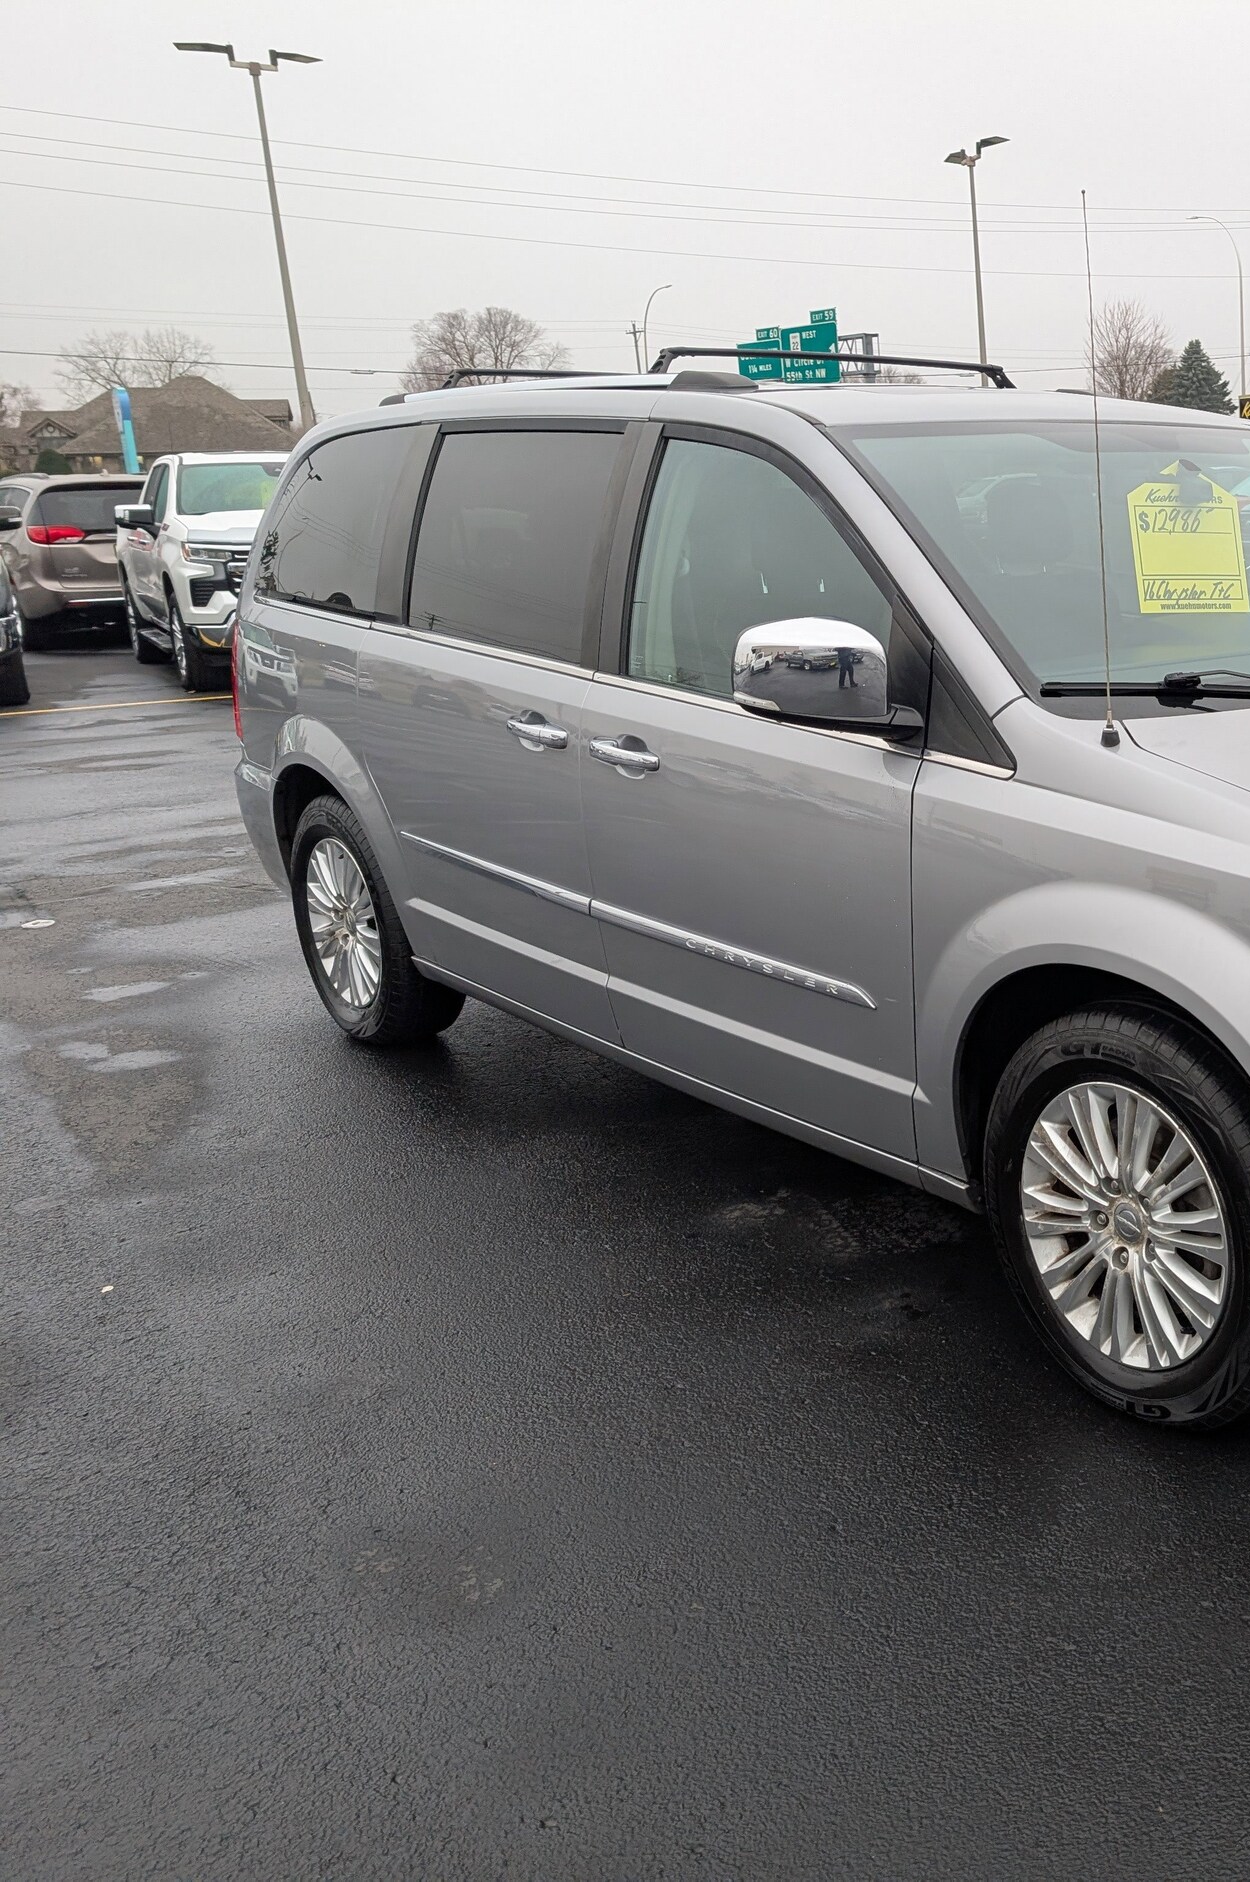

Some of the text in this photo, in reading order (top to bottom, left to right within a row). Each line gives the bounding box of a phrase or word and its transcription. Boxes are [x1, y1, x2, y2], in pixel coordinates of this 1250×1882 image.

[812, 311, 834, 321] EXIT 59
[769, 328, 778, 338] 60
[801, 330, 817, 339] WEST
[791, 341, 799, 350] 22
[758, 364, 772, 372] MILES
[786, 368, 826, 381] 55th St NW
[1160, 602, 1232, 610] www.kuehnmotors.com
[685, 938, 838, 995] CHRYSLER
